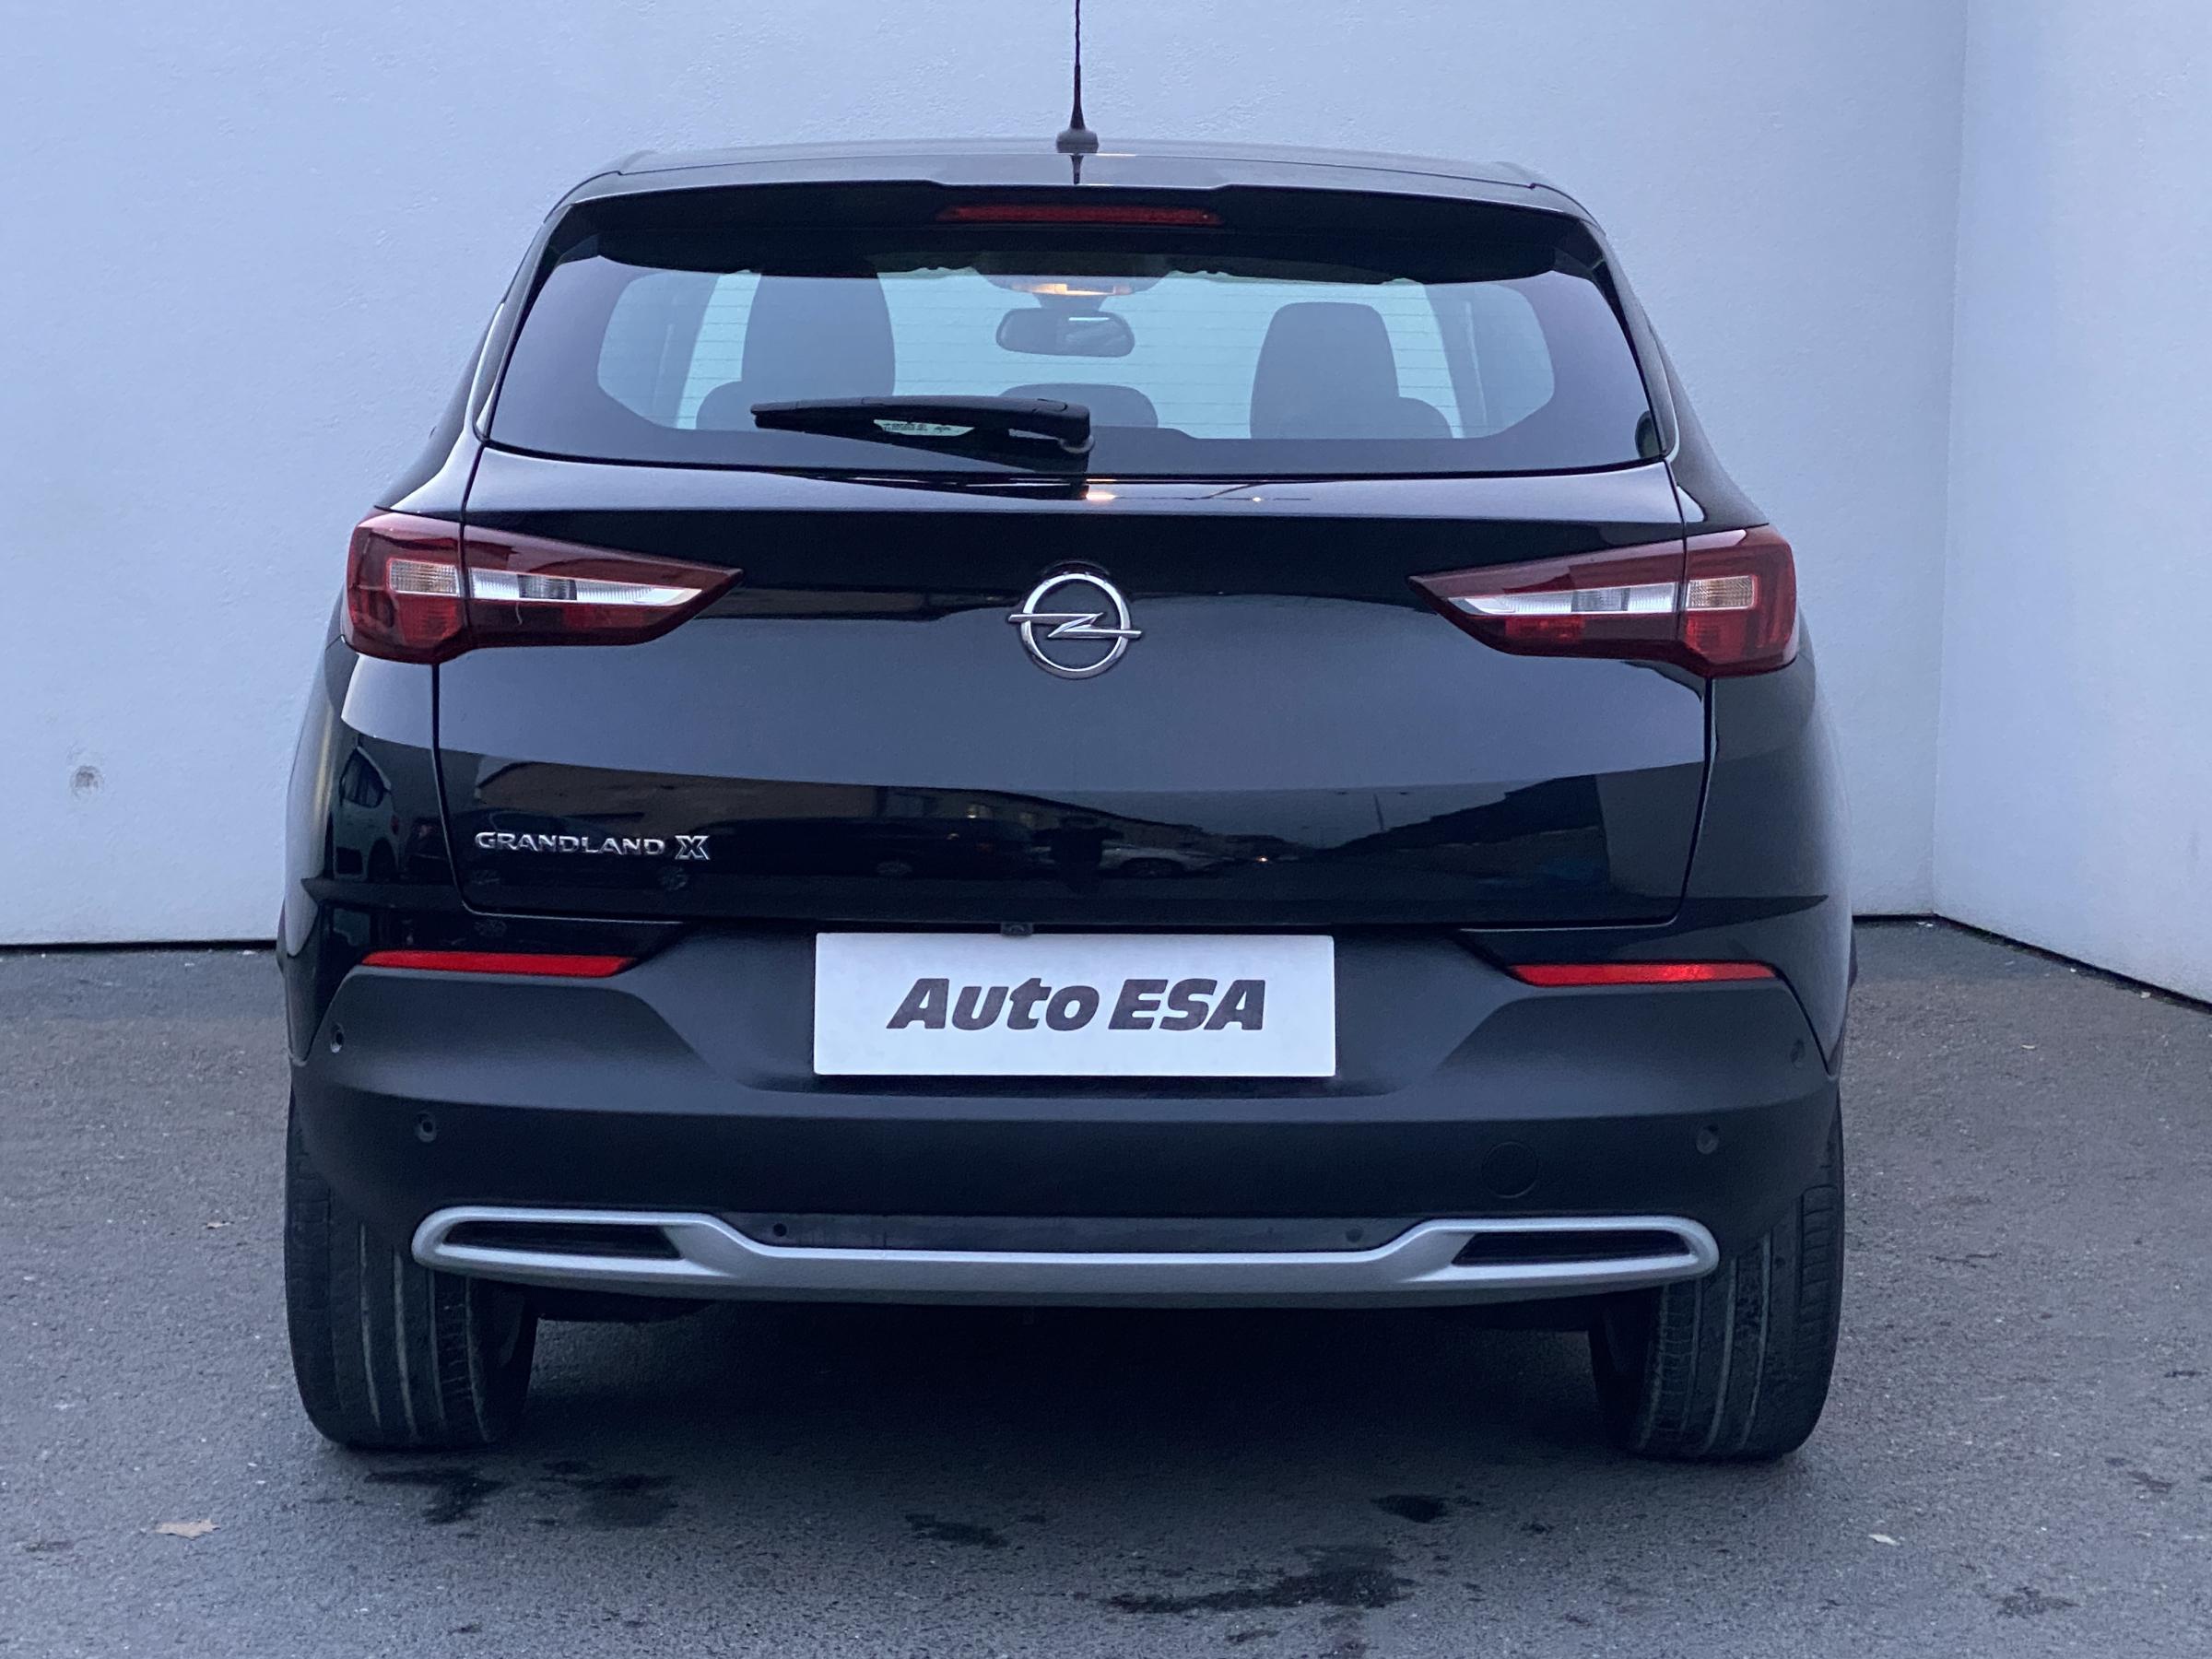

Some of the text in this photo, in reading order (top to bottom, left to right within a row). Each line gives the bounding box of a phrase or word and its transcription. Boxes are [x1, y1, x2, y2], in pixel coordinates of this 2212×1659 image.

[475, 831, 710, 860] GRANDLAND X
[886, 978, 1266, 1031] Auto ESA
